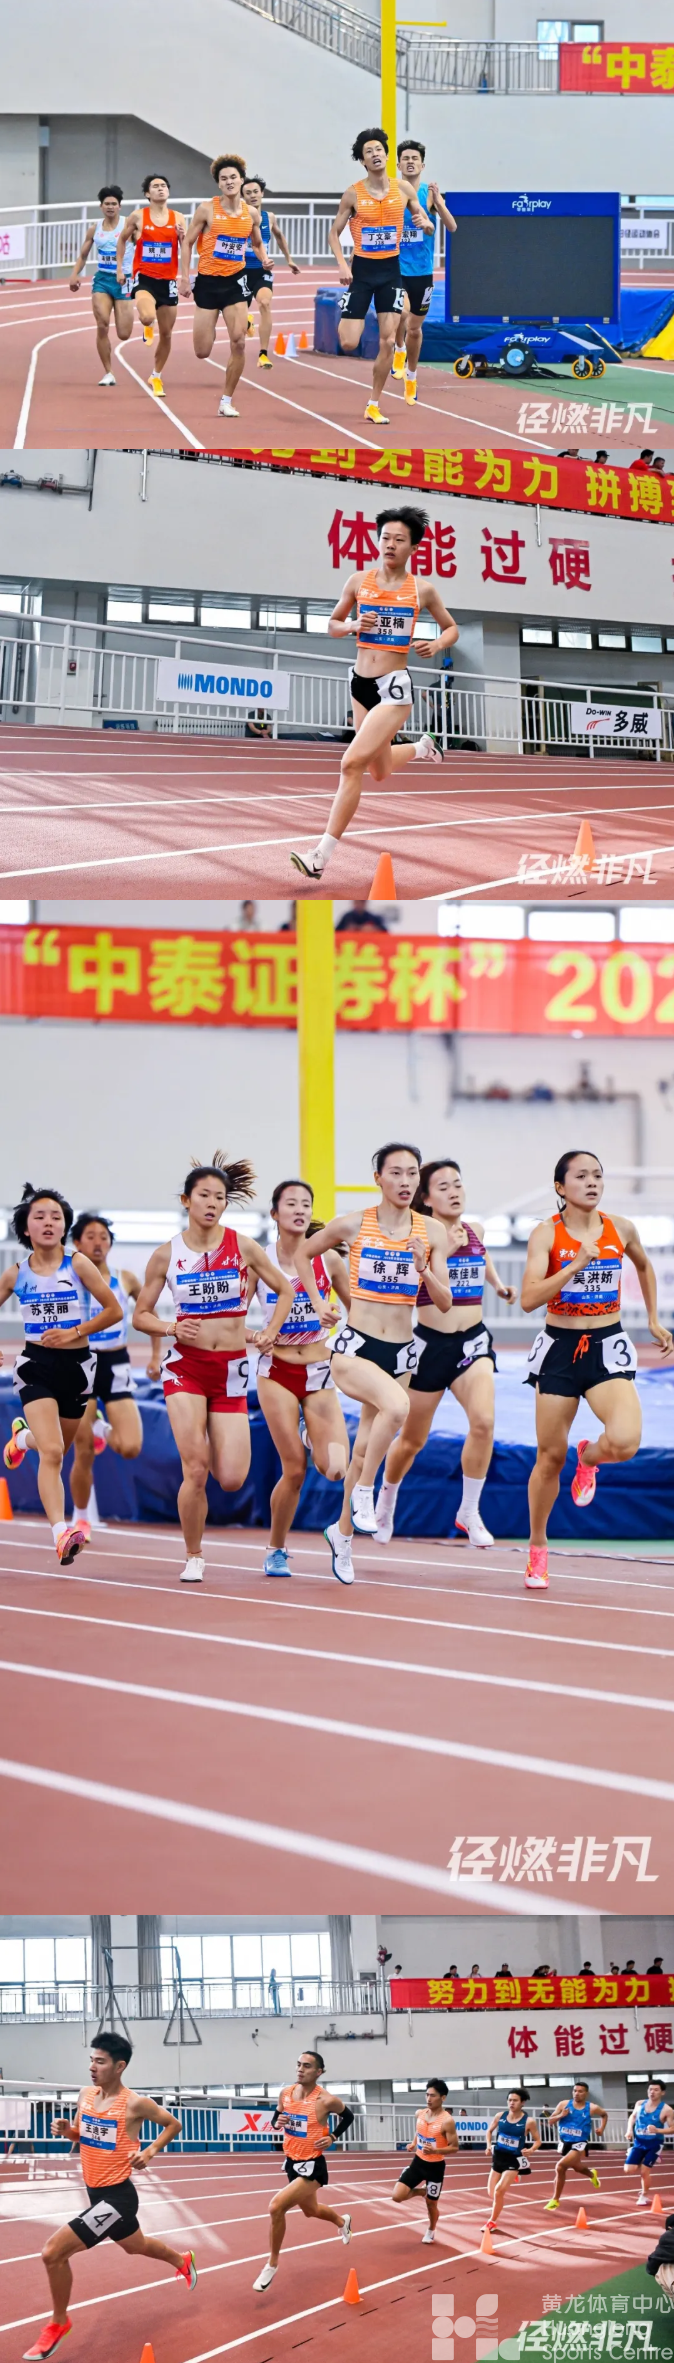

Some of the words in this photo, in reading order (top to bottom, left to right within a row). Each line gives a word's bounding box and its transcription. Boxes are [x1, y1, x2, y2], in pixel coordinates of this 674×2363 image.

[327, 508, 592, 591] 体能过硬
[195, 674, 272, 698] MONDO
[388, 676, 404, 700] 6
[613, 710, 648, 734] 多威
[381, 1275, 399, 1283] 355
[449, 1267, 479, 1280] 陈佳慧
[573, 1271, 613, 1285] 吴洪娇
[188, 1281, 229, 1296] 王盼盼
[201, 1295, 219, 1303] 129
[30, 1302, 69, 1317] 苏荣丽
[42, 1315, 58, 1323] 170
[289, 1315, 305, 1323] 128
[334, 1328, 355, 1354] 8
[613, 1339, 632, 1367] 3
[427, 1978, 650, 2005] 努力到无能为力
[507, 2023, 674, 2059] 体能过硬
[298, 2162, 307, 2172] 6
[521, 2158, 527, 2168] 5
[429, 2184, 438, 2195] 8
[93, 2212, 113, 2228] 4
